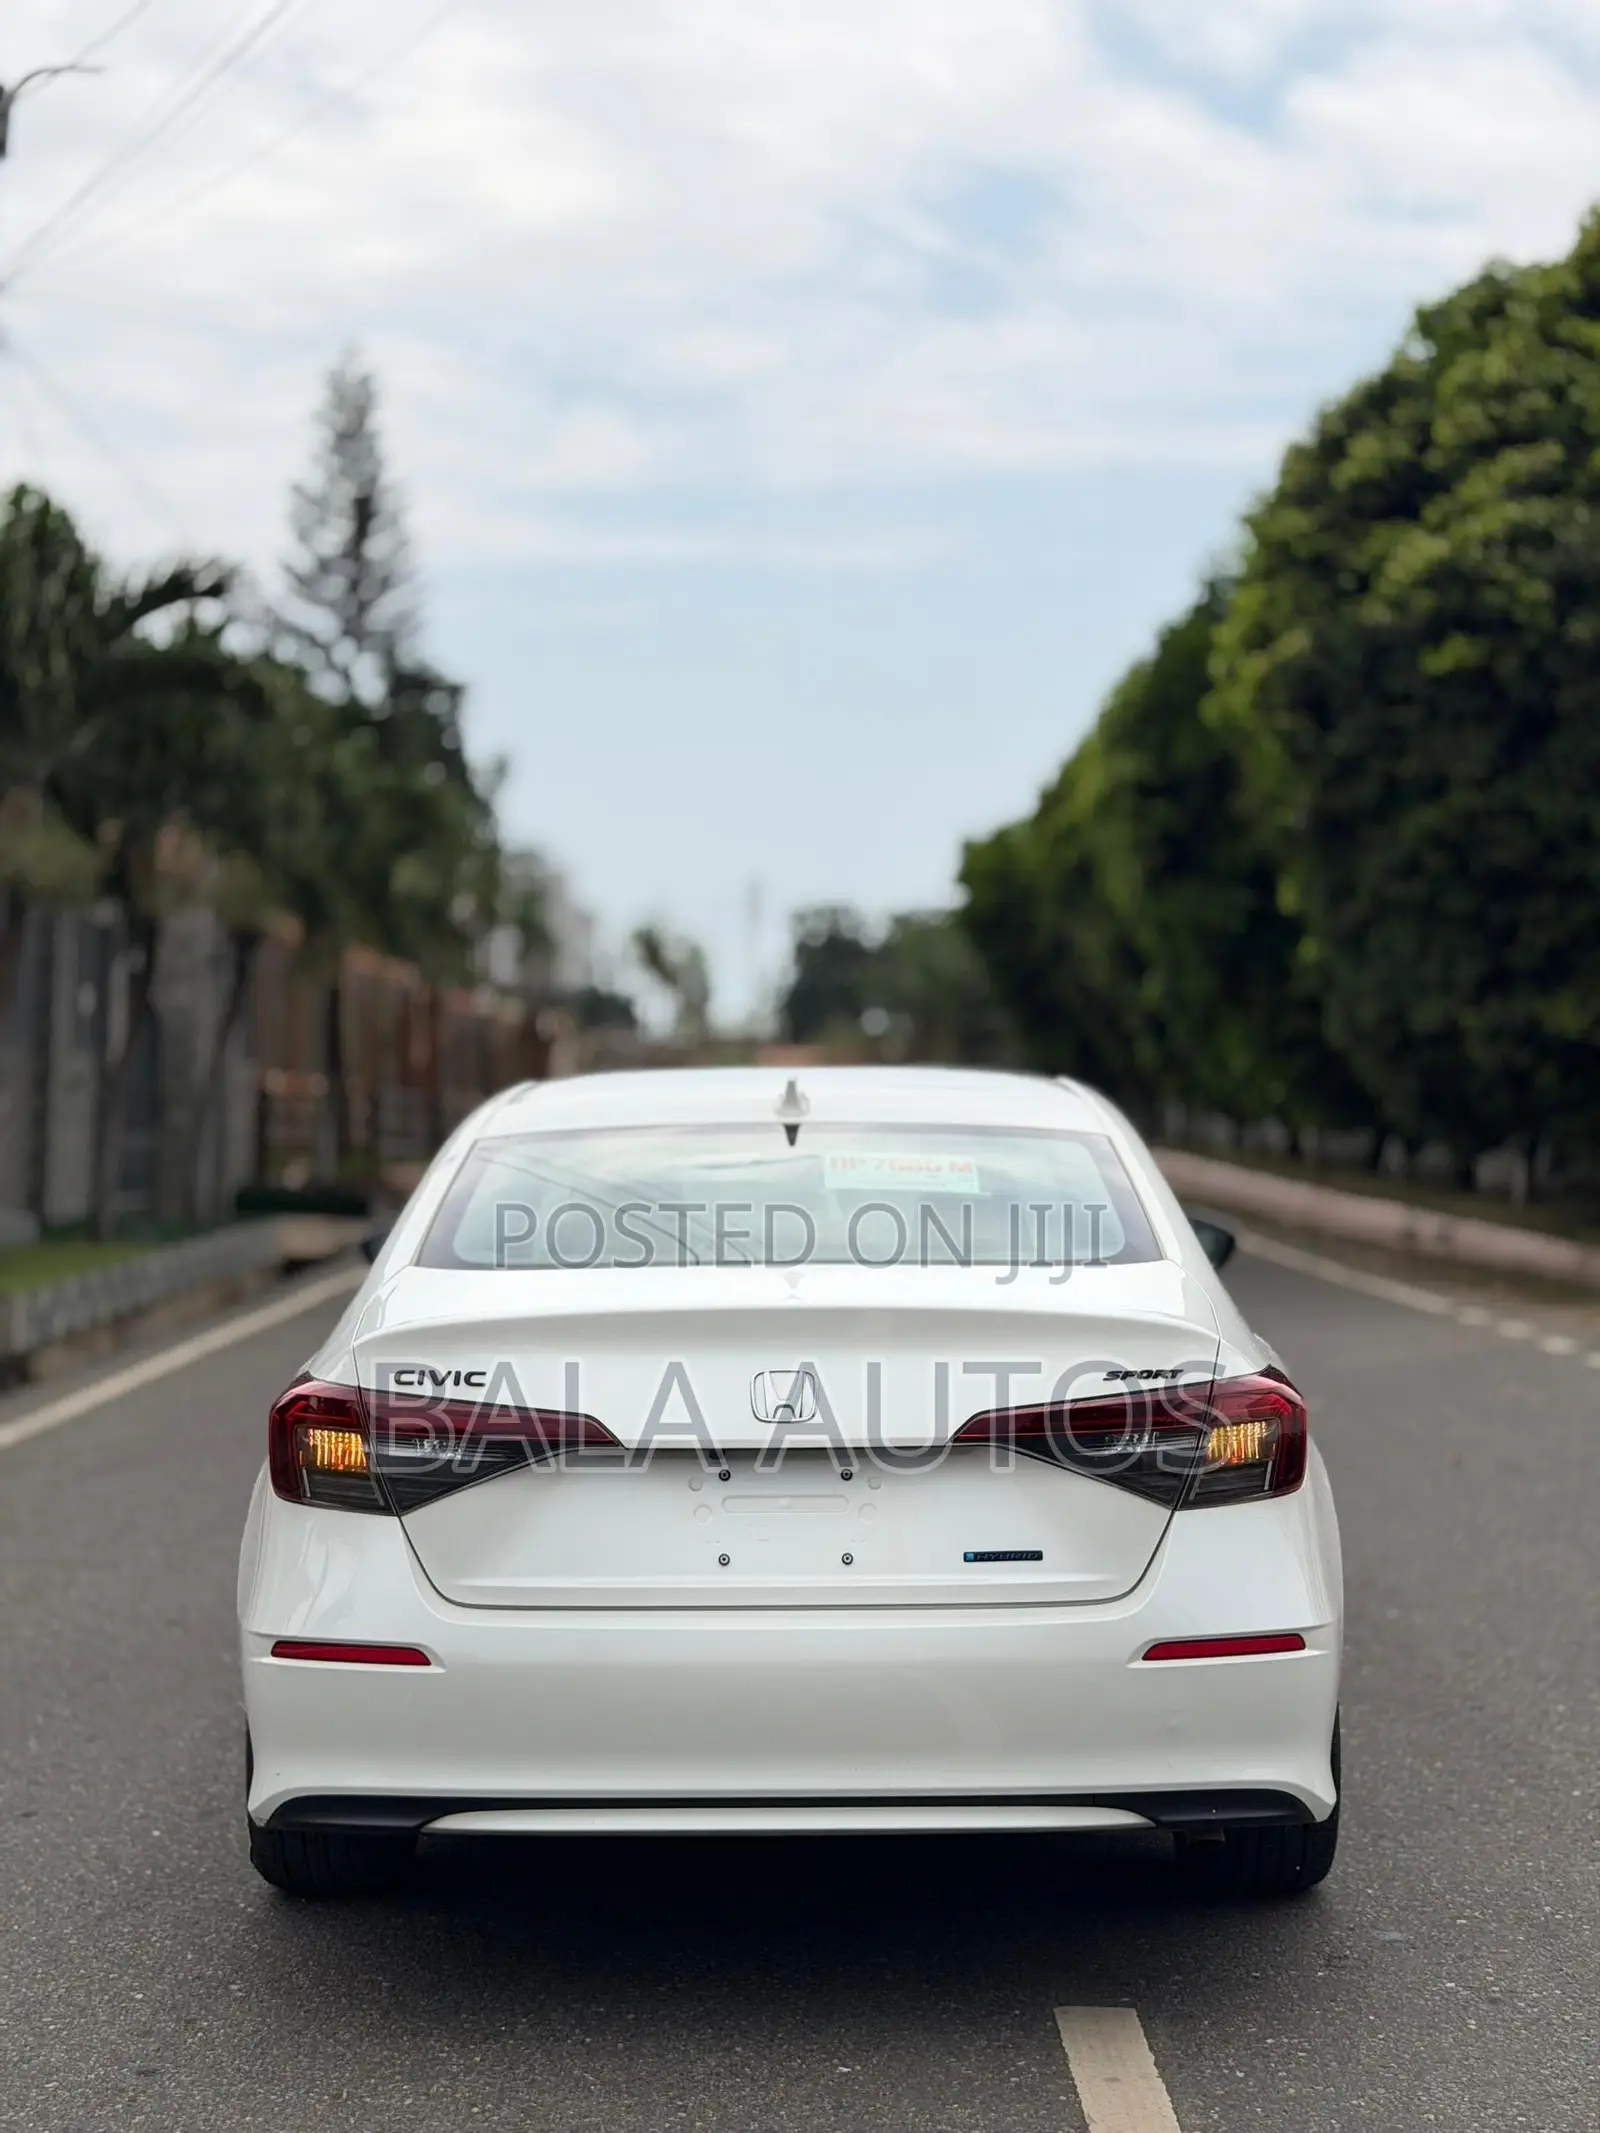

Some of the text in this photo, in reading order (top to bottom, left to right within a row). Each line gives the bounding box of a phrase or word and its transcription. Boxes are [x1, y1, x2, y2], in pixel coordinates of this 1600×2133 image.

[394, 1368, 487, 1387] CIVIC
[1102, 1368, 1184, 1382] SPORT
[976, 1552, 1039, 1561] HYBRID
